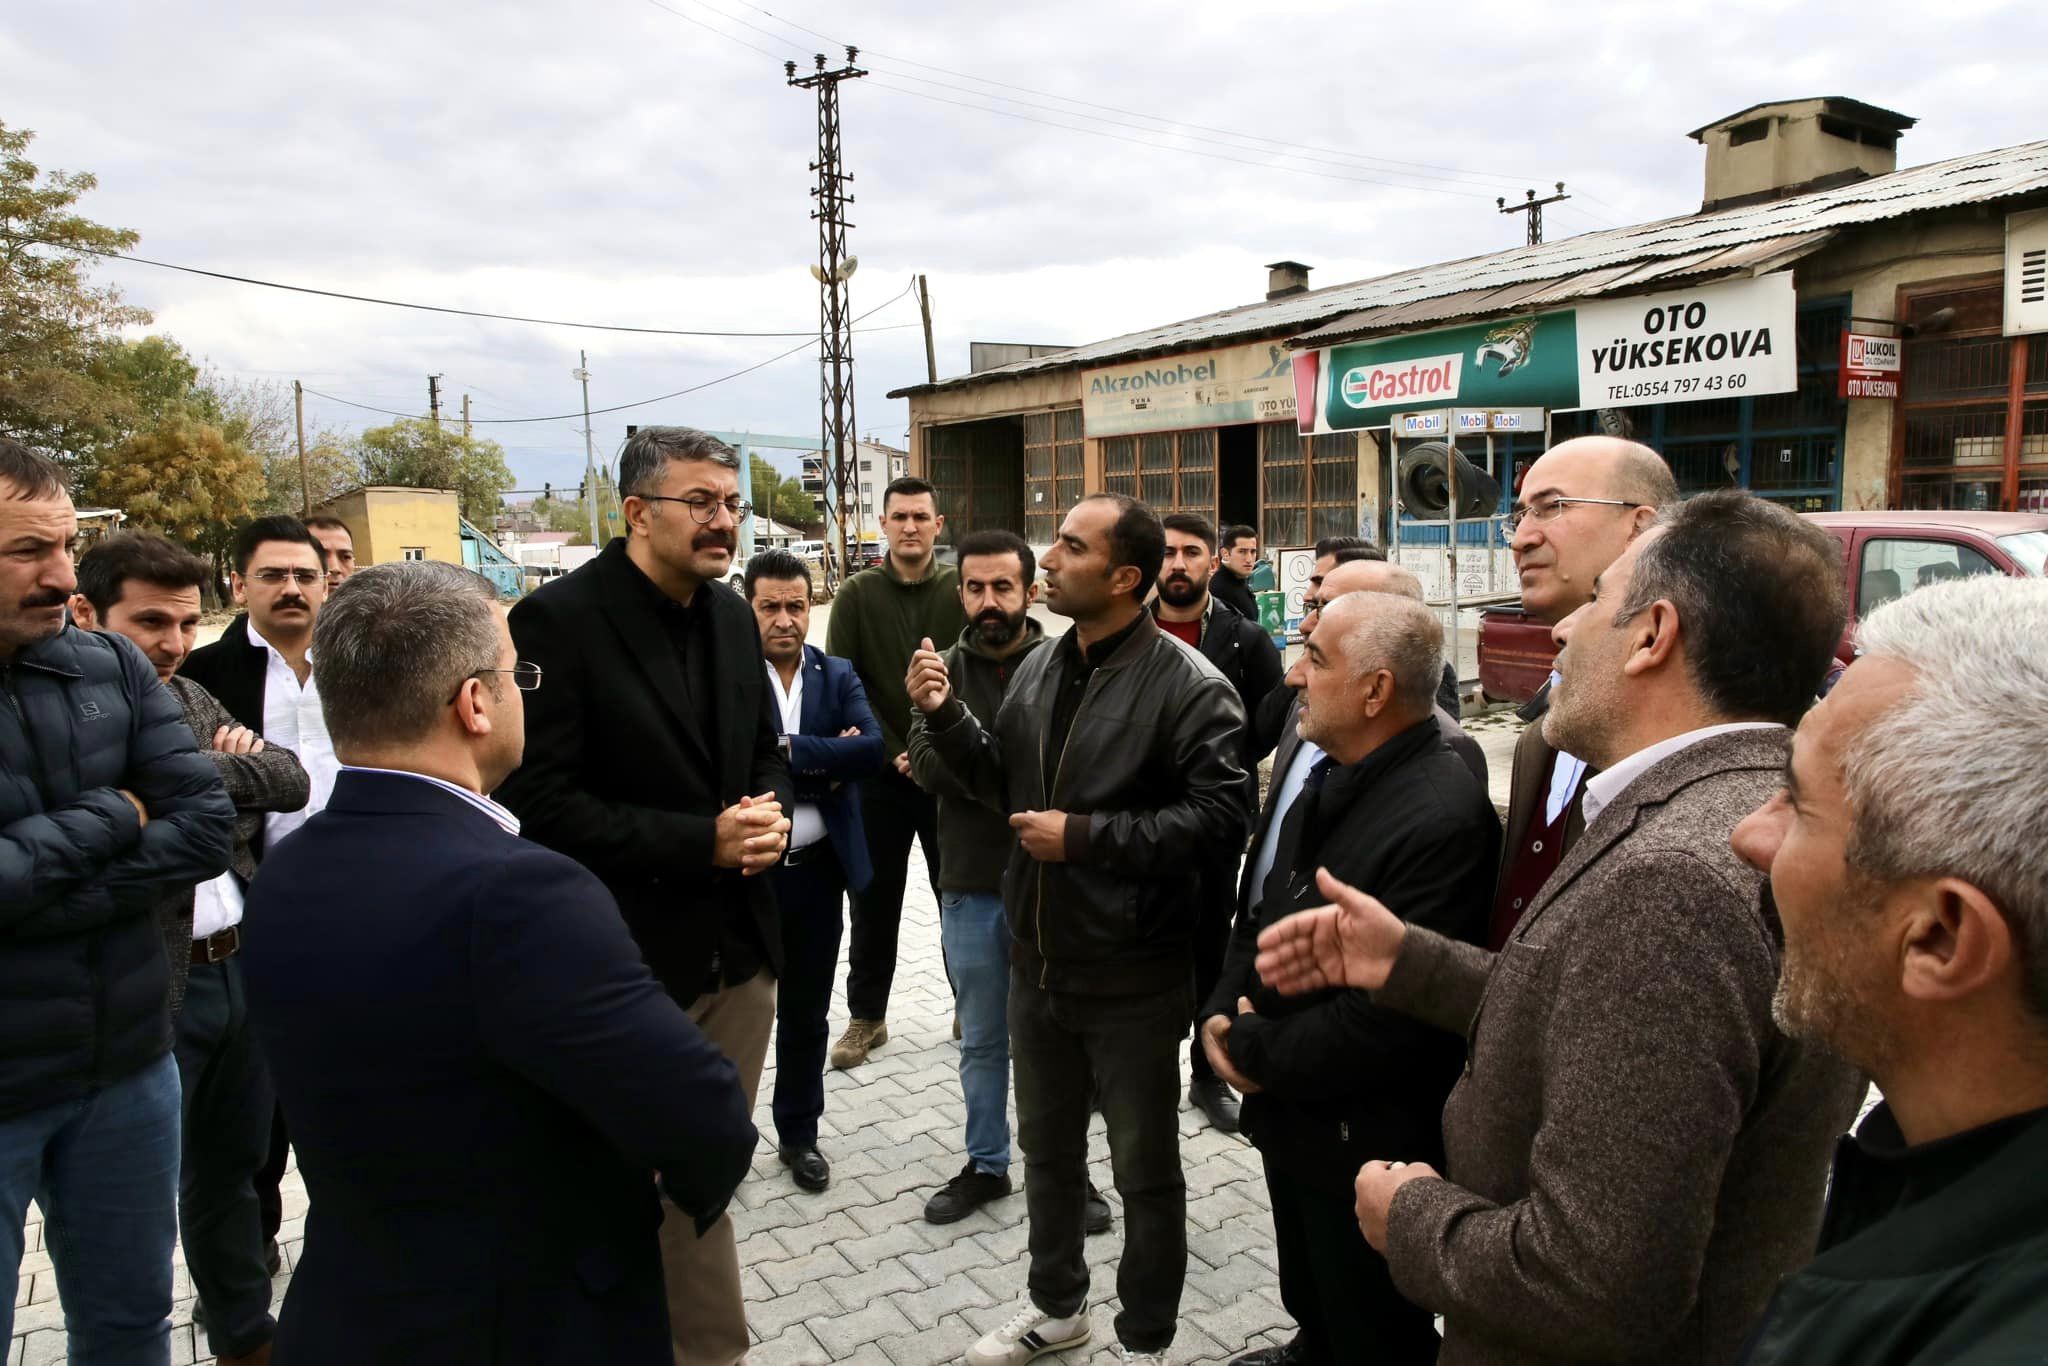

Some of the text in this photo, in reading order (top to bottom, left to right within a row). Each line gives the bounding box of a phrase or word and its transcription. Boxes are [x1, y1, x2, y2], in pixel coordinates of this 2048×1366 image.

[1644, 301, 1707, 335] OTO
[1591, 327, 1772, 374] YÜKSEKOVA
[1866, 342, 1896, 357] LUKOIL
[1090, 359, 1216, 395] AkzoNobel
[1368, 360, 1452, 401] Castrol
[1608, 373, 1747, 400] TEL:0554 797 43 60
[1848, 379, 1861, 396] OTO
[1259, 400, 1277, 411] OTO
[1407, 416, 1439, 430] Mobil
[1460, 415, 1486, 427] Mobil
[1495, 415, 1520, 427] Mobil
